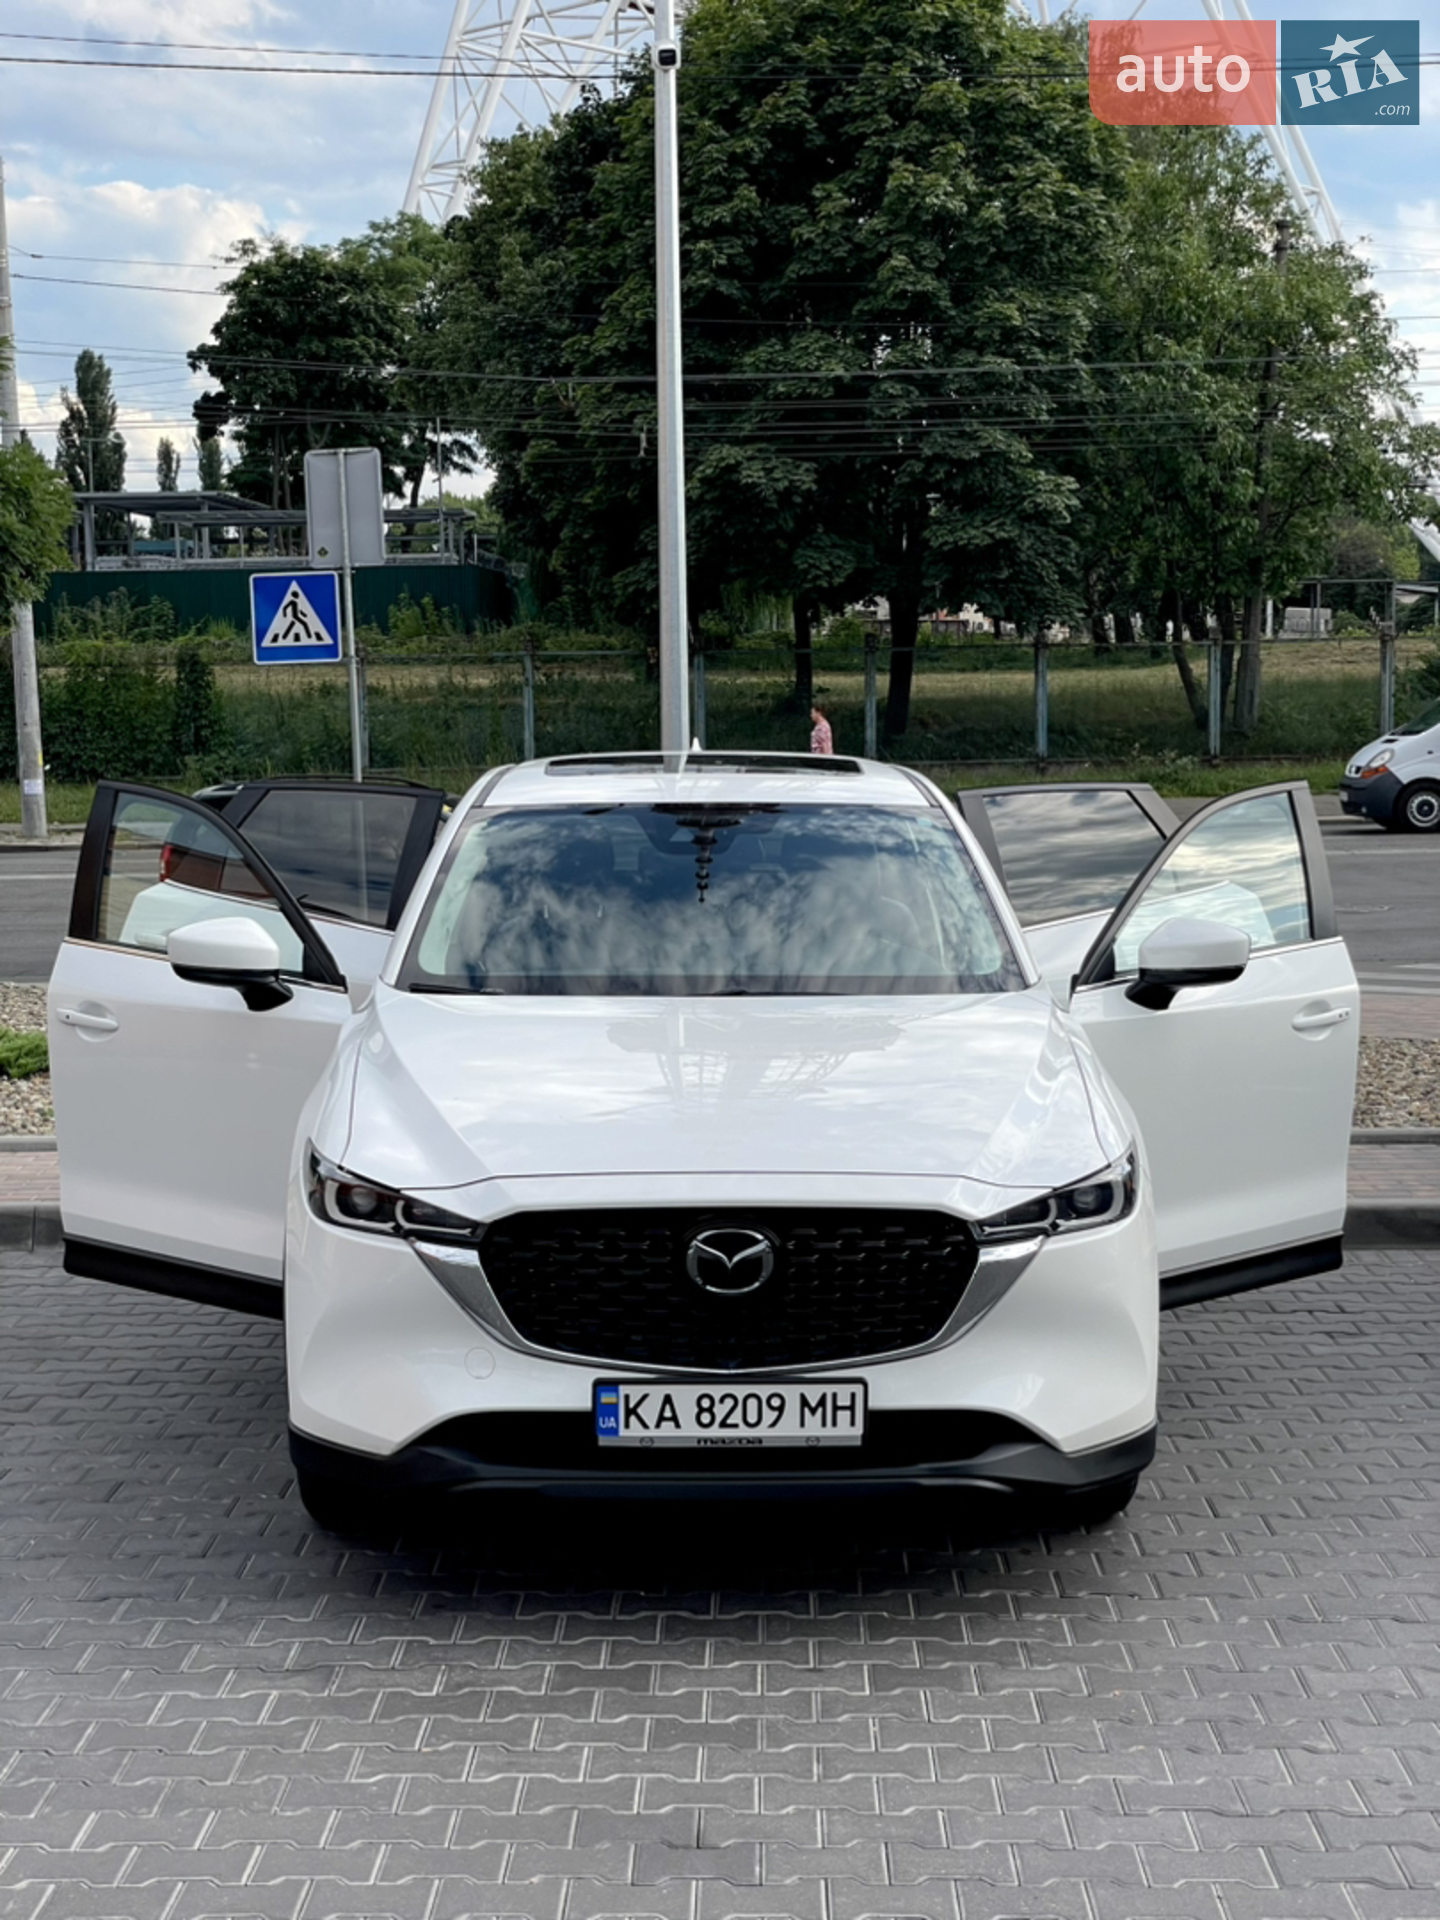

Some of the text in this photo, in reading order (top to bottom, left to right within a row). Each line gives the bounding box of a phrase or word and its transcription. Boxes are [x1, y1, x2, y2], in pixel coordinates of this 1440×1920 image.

[599, 1417, 618, 1429] UA
[623, 1391, 856, 1430] KA 8209 MH
